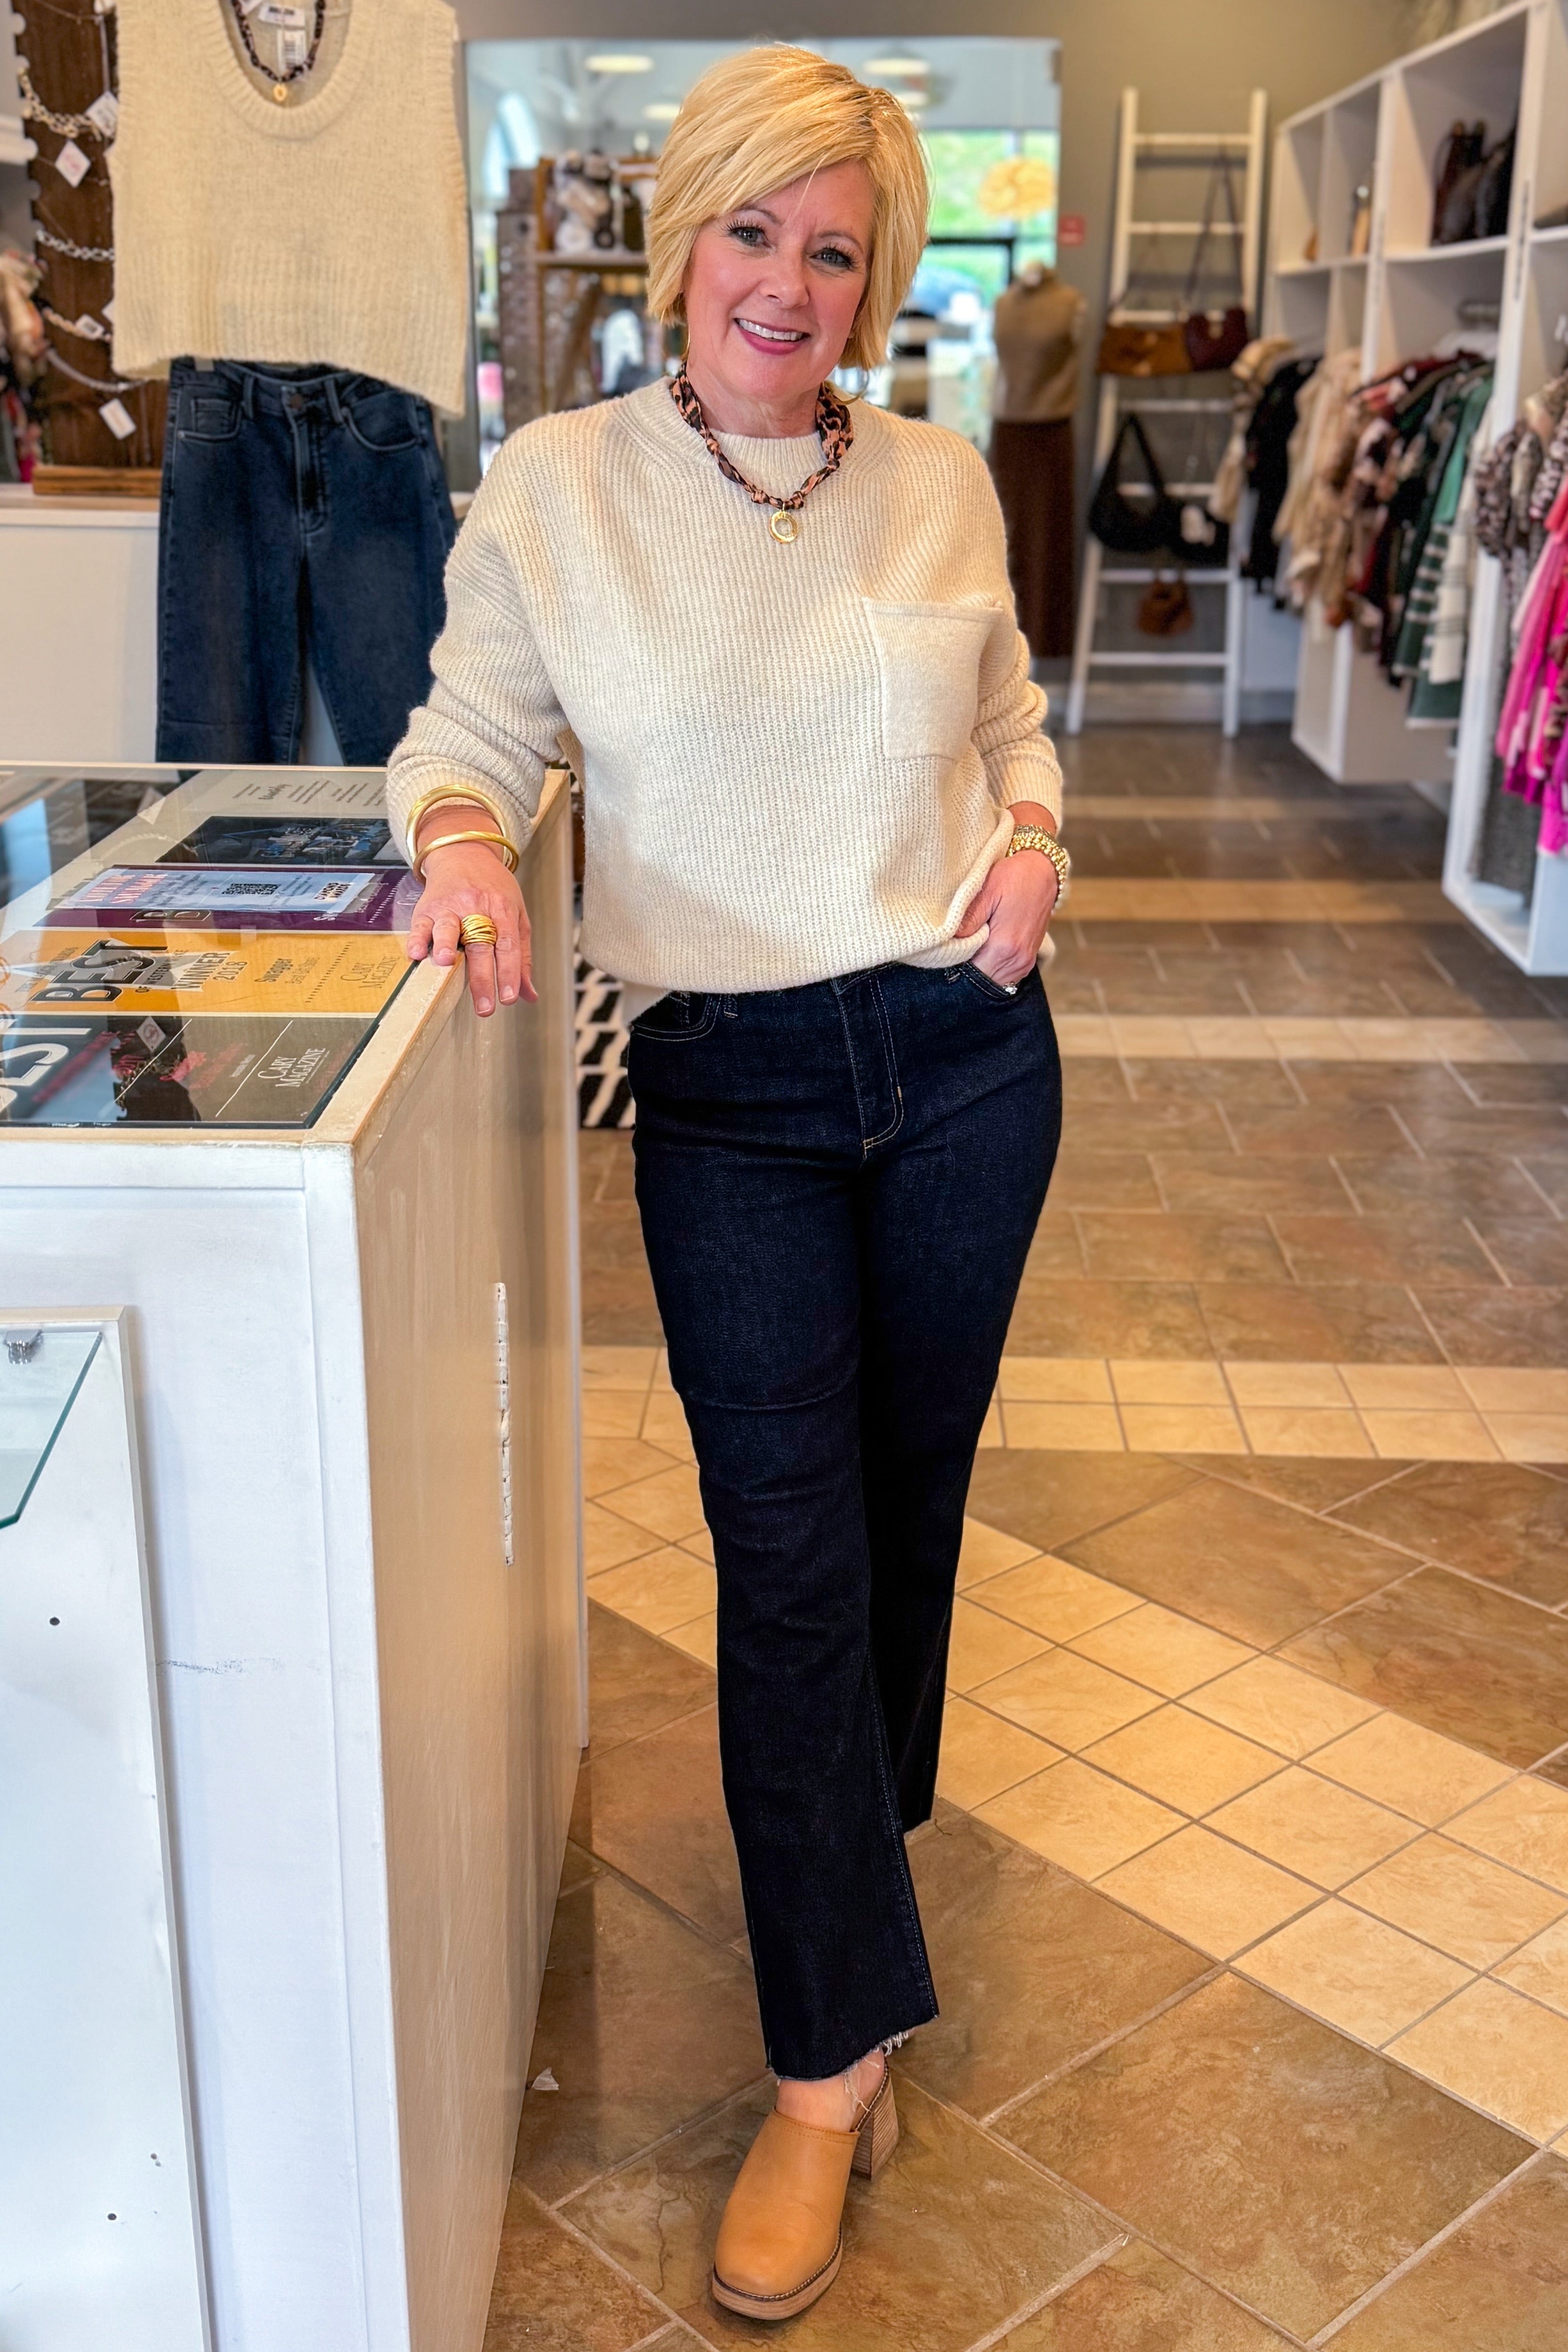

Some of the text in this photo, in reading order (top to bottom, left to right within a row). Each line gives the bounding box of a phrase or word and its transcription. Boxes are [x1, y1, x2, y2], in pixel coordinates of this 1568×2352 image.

[29, 939, 168, 1001] BEST
[171, 952, 230, 989] WINNER
[212, 961, 247, 980] 2018
[255, 958, 293, 982] Swagger
[341, 963, 375, 981] CARY
[359, 956, 401, 988] MAGAZINE
[258, 1057, 296, 1079] CARY
[276, 1047, 326, 1087] MAGAZINE
